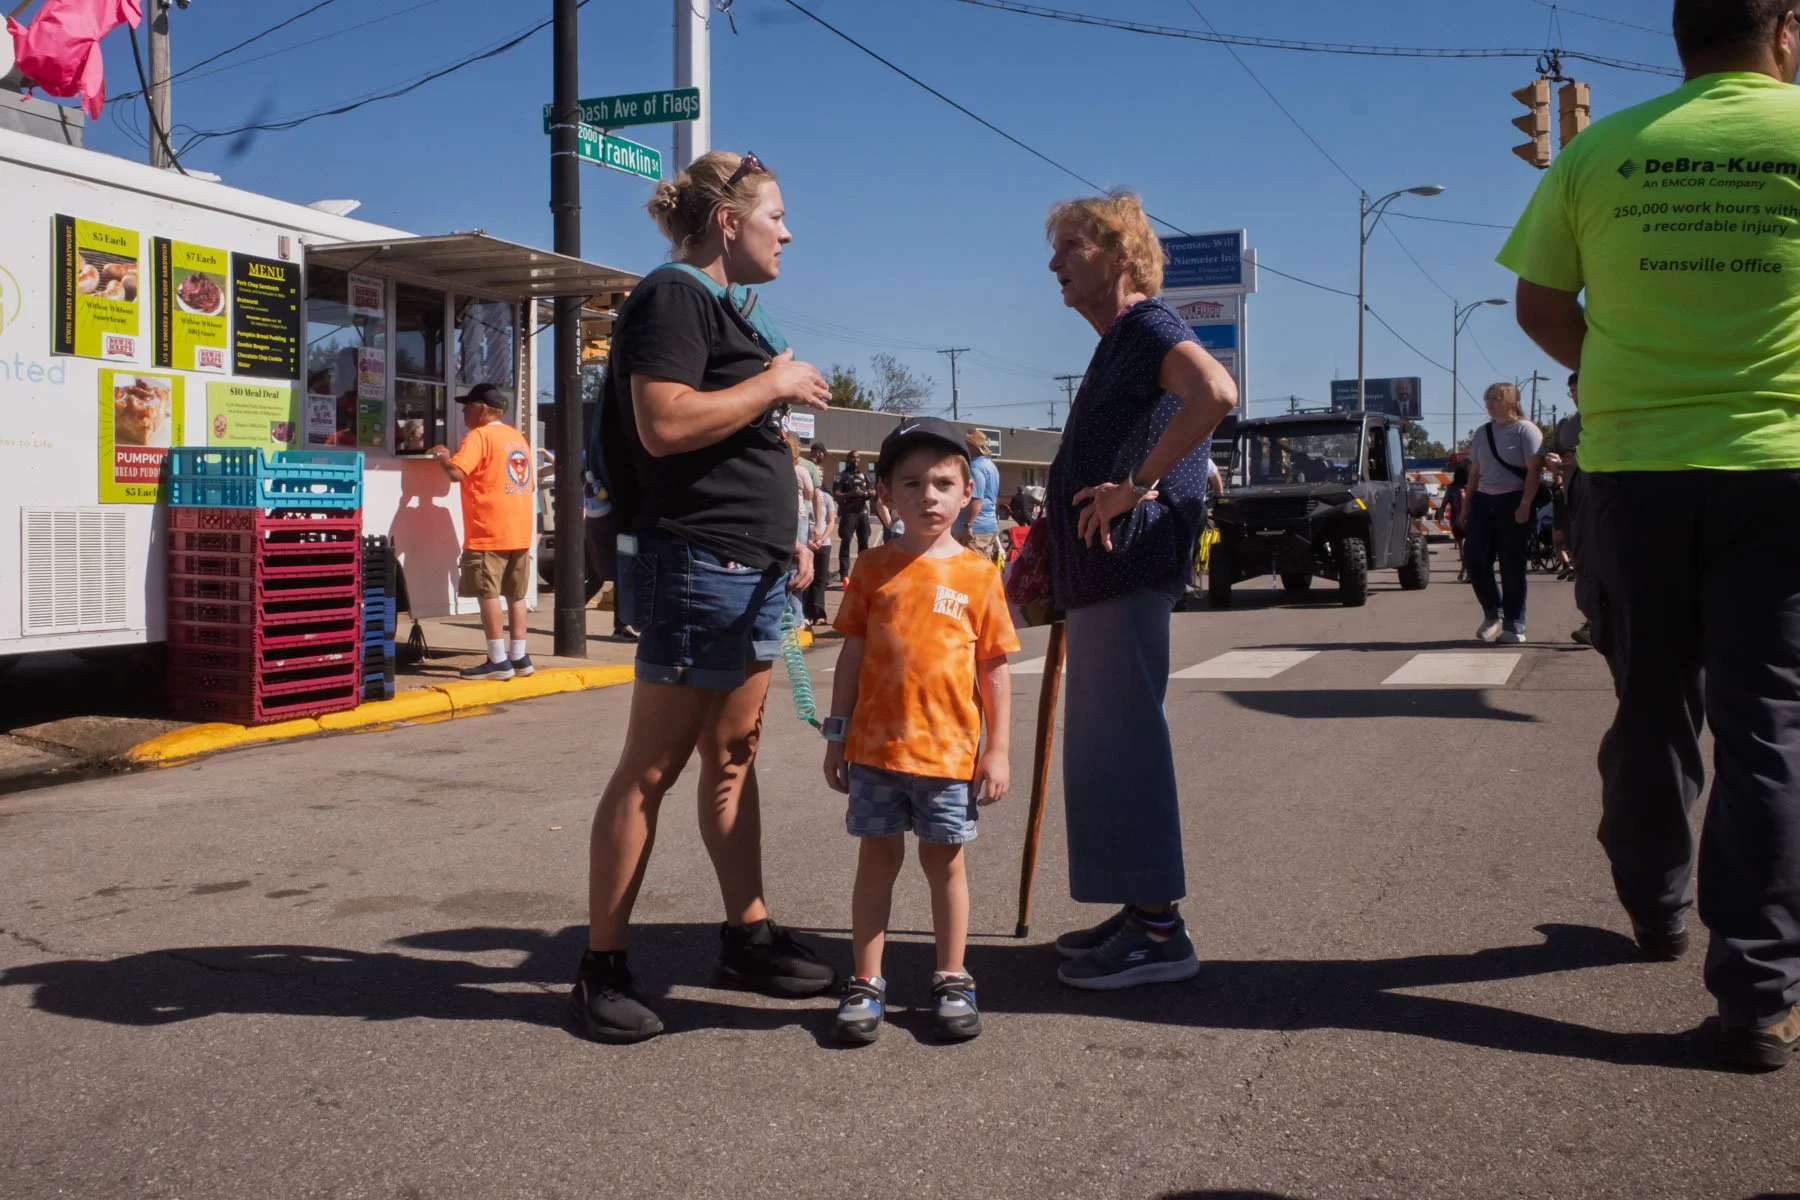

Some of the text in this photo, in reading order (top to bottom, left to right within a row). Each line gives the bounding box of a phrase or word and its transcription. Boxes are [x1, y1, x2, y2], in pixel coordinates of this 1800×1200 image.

[614, 99, 637, 118] Ave
[644, 95, 657, 115] of
[663, 93, 698, 118] Flags
[578, 126, 598, 143] 2000
[585, 143, 591, 157] W
[599, 135, 651, 174] Franklin
[1645, 157, 1800, 180] DeBra-Kuem
[1643, 178, 1766, 190] An EMCOR Company
[1614, 202, 1668, 218] 250,000
[1673, 201, 1711, 214] work
[1715, 201, 1760, 215] hours
[1643, 219, 1788, 237] a recordable injury
[105, 234, 126, 247] Each
[1166, 237, 1234, 251] Freeman, Will
[197, 253, 217, 265] Each
[1173, 254, 1218, 266] Niemeier
[1640, 258, 1782, 273] Evansville Office
[249, 262, 284, 278] MENU
[230, 387, 280, 399] $10 Meal Deal
[115, 466, 138, 477] BREAD
